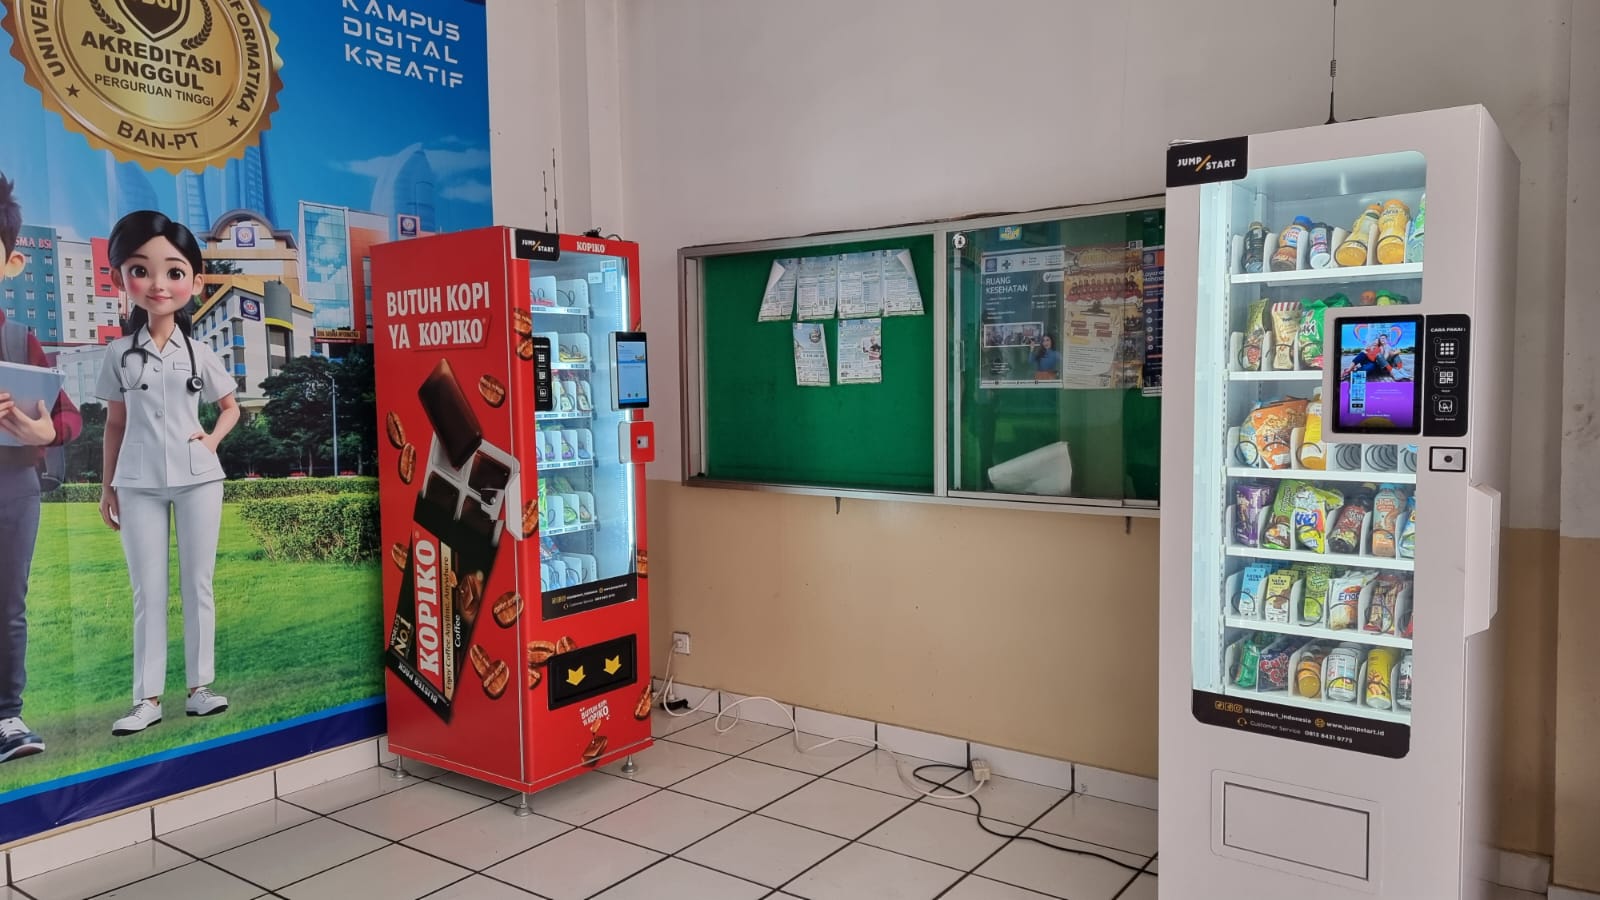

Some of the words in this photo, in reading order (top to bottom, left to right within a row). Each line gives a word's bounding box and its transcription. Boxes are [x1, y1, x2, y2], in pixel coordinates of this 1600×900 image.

[342, 0, 460, 41] KAMPUS
[30, 0, 66, 78] UNIVE
[81, 30, 222, 76] AKREDITASI
[343, 16, 458, 64] DIGITAL
[104, 55, 204, 91] UNGGUL
[228, 0, 261, 113] FORMATIKA
[345, 43, 463, 88] KREATIF
[94, 73, 173, 99] PERGURUAN
[175, 90, 214, 107] TINGGI
[117, 120, 200, 151] BAN-PT
[1177, 156, 1202, 167] JUMP
[1205, 158, 1237, 170] START
[537, 245, 555, 253] START
[576, 241, 606, 253] KOPIKO
[985, 276, 1012, 286] RUANG
[985, 284, 1028, 294] KESEHATAN
[386, 286, 442, 317] BUTUH
[446, 281, 490, 312] KOPI
[388, 323, 411, 350] YA
[418, 318, 483, 347] KOPIKO
[443, 556, 451, 600] Anywhere
[415, 539, 440, 677] KOPIKO
[445, 638, 453, 668] Coffee
[1249, 720, 1278, 730] Customer
[1279, 725, 1301, 735] Service
[1326, 721, 1385, 736] www.jumpstart.id
